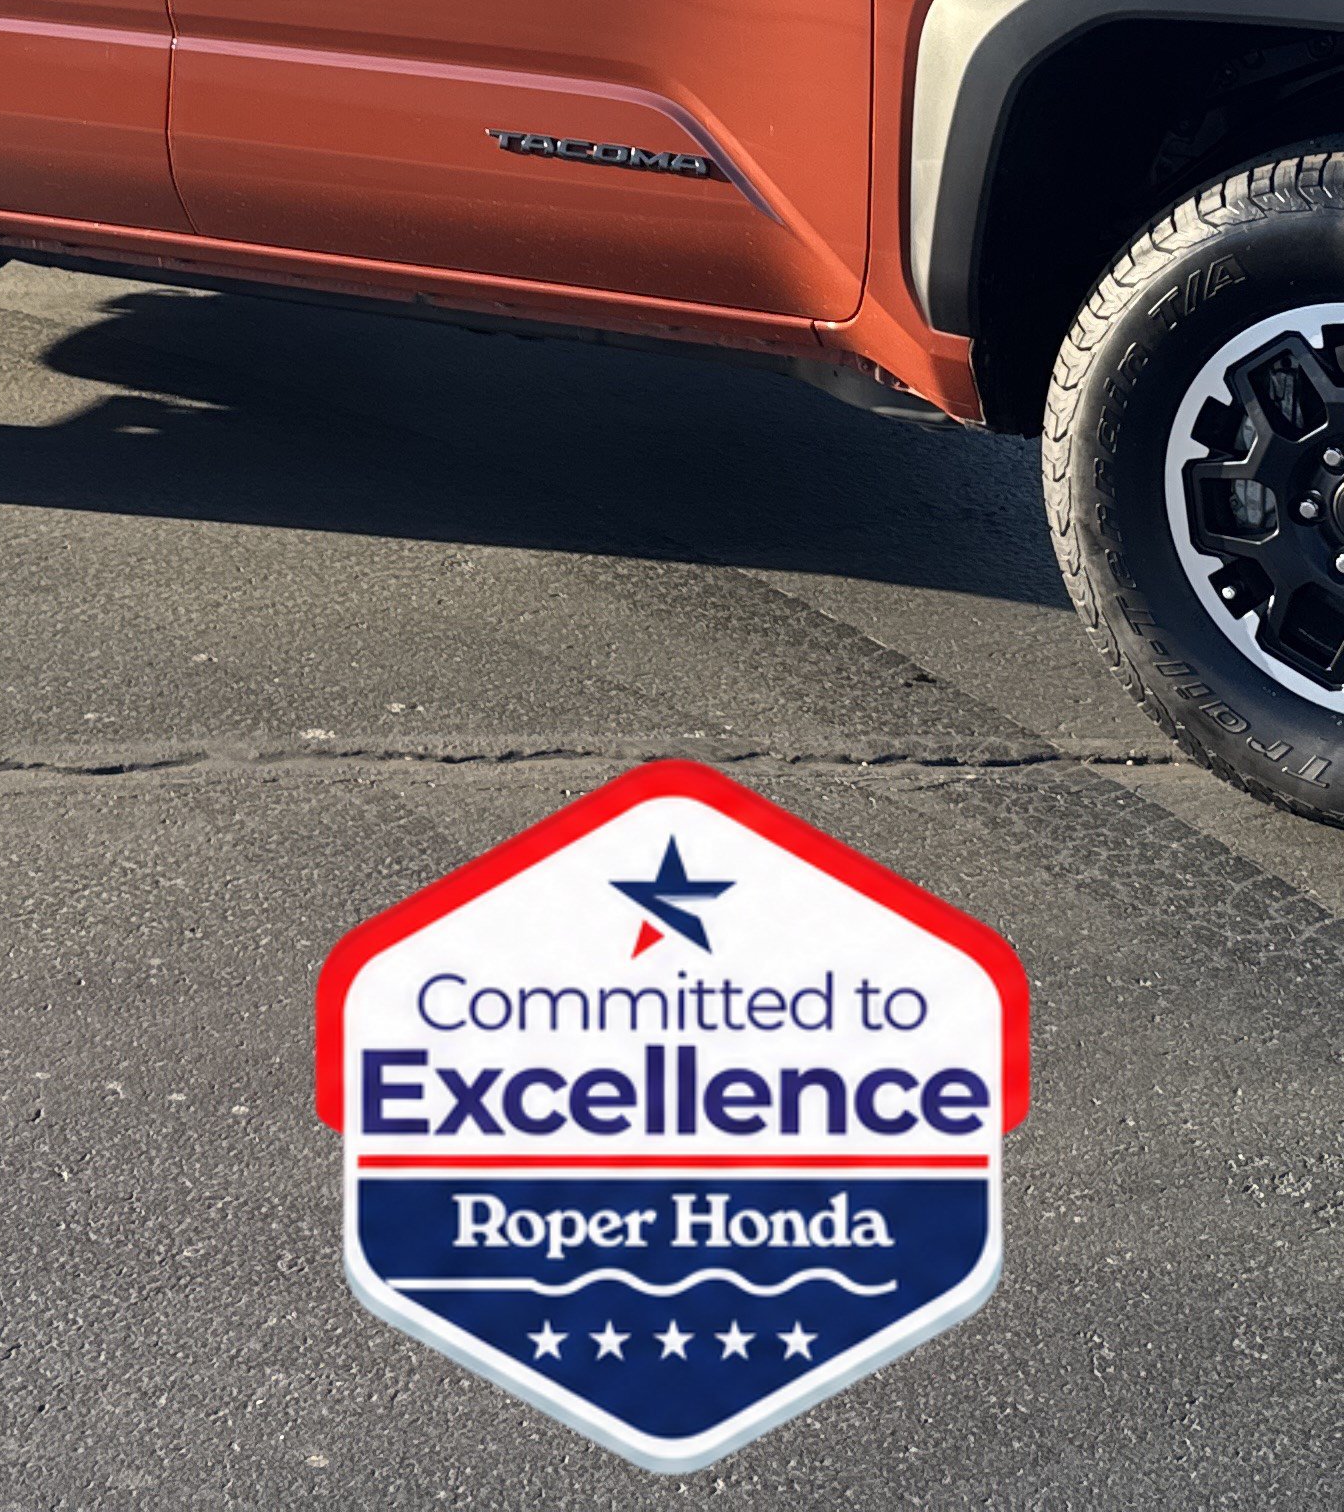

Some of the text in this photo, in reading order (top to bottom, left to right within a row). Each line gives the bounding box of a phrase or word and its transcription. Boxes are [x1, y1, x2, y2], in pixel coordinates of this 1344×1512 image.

[485, 128, 712, 179] TACOMA
[1093, 253, 1333, 791] Trail-Terrain T/A
